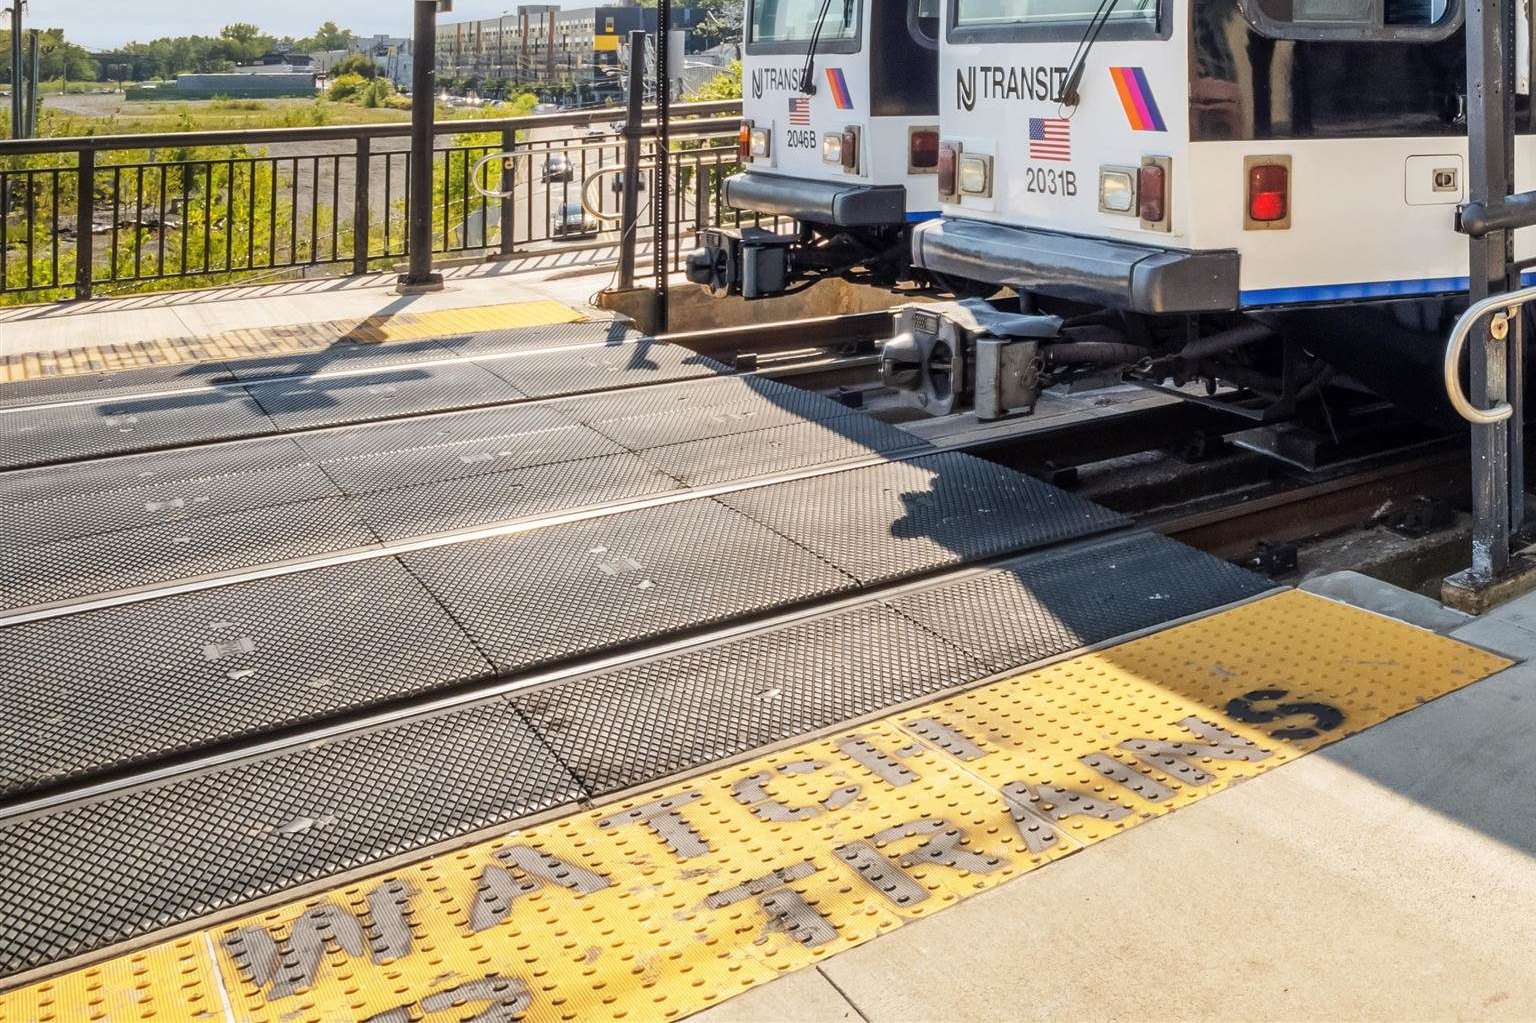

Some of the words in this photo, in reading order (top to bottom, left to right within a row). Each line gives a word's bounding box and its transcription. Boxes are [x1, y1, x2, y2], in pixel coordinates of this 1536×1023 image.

[956, 66, 977, 112] NJ
[980, 65, 1068, 102] TRANSIT
[787, 129, 817, 149] 2046B
[1026, 167, 1077, 197] 2031B
[703, 686, 1347, 949] TRAINS
